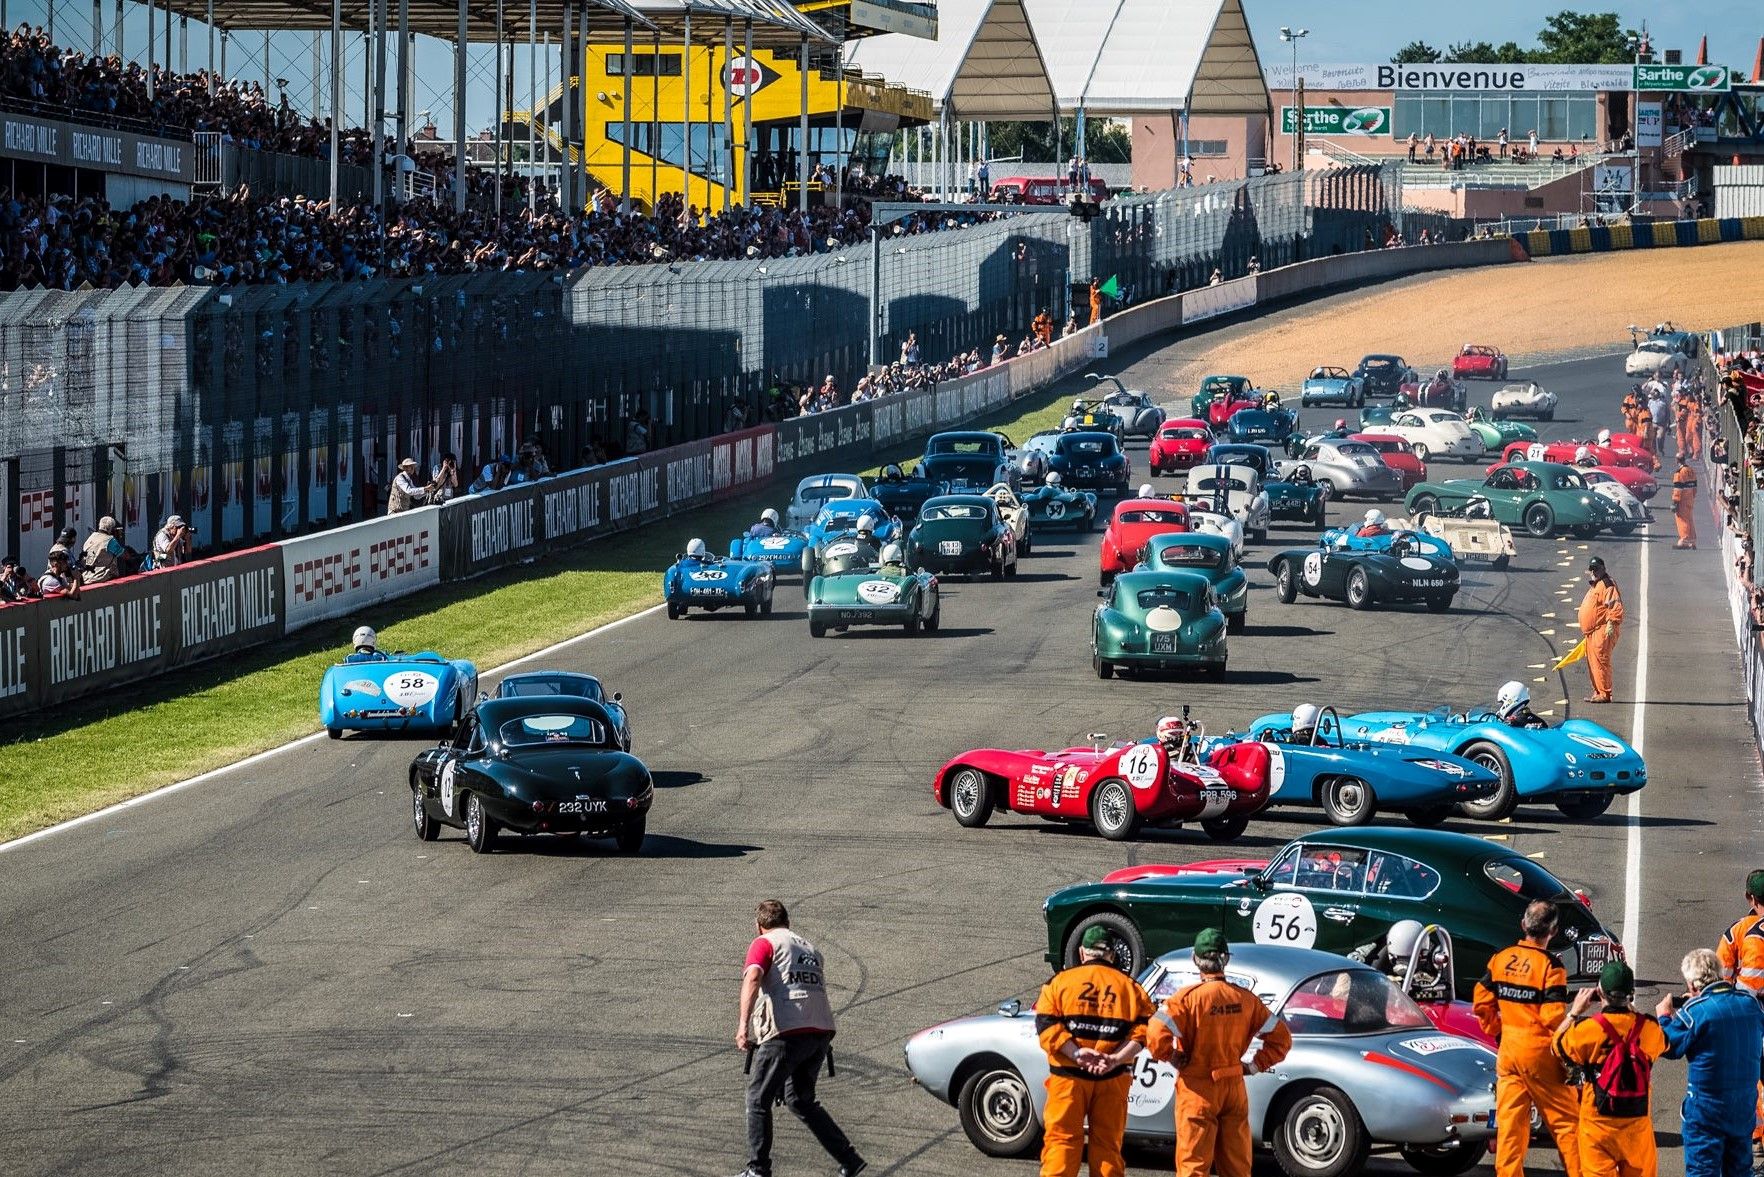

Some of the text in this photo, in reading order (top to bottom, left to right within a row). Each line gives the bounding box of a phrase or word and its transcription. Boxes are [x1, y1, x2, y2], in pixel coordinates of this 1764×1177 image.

[1377, 65, 1525, 89] Bienvenue
[1638, 68, 1684, 81] Sarthe
[5, 121, 57, 156] RICHARD MILLE
[73, 132, 122, 165] RICHARD MILLE
[136, 142, 181, 174] RICHARD MILLE
[1098, 342, 1105, 352] 2
[609, 465, 659, 520] RICHARD MILLE
[545, 481, 600, 540] RICHARD MILLE
[472, 498, 535, 562] RICHARD MILLE
[293, 530, 429, 606] PORSCHE PORSCHE
[1308, 561, 1319, 575] 54
[866, 584, 891, 594] 32
[1412, 578, 1429, 587] NLN
[180, 566, 276, 648] RICHARD MILLE
[50, 594, 162, 685] RICHARD MILLE
[1154, 643, 1172, 652] UXM
[1155, 633, 1171, 643] 175
[400, 677, 425, 689] 58
[1130, 755, 1148, 774] 16
[559, 801, 608, 814] 232 UYK
[1268, 914, 1301, 941] 56
[1076, 1022, 1119, 1034] DUNLOP
